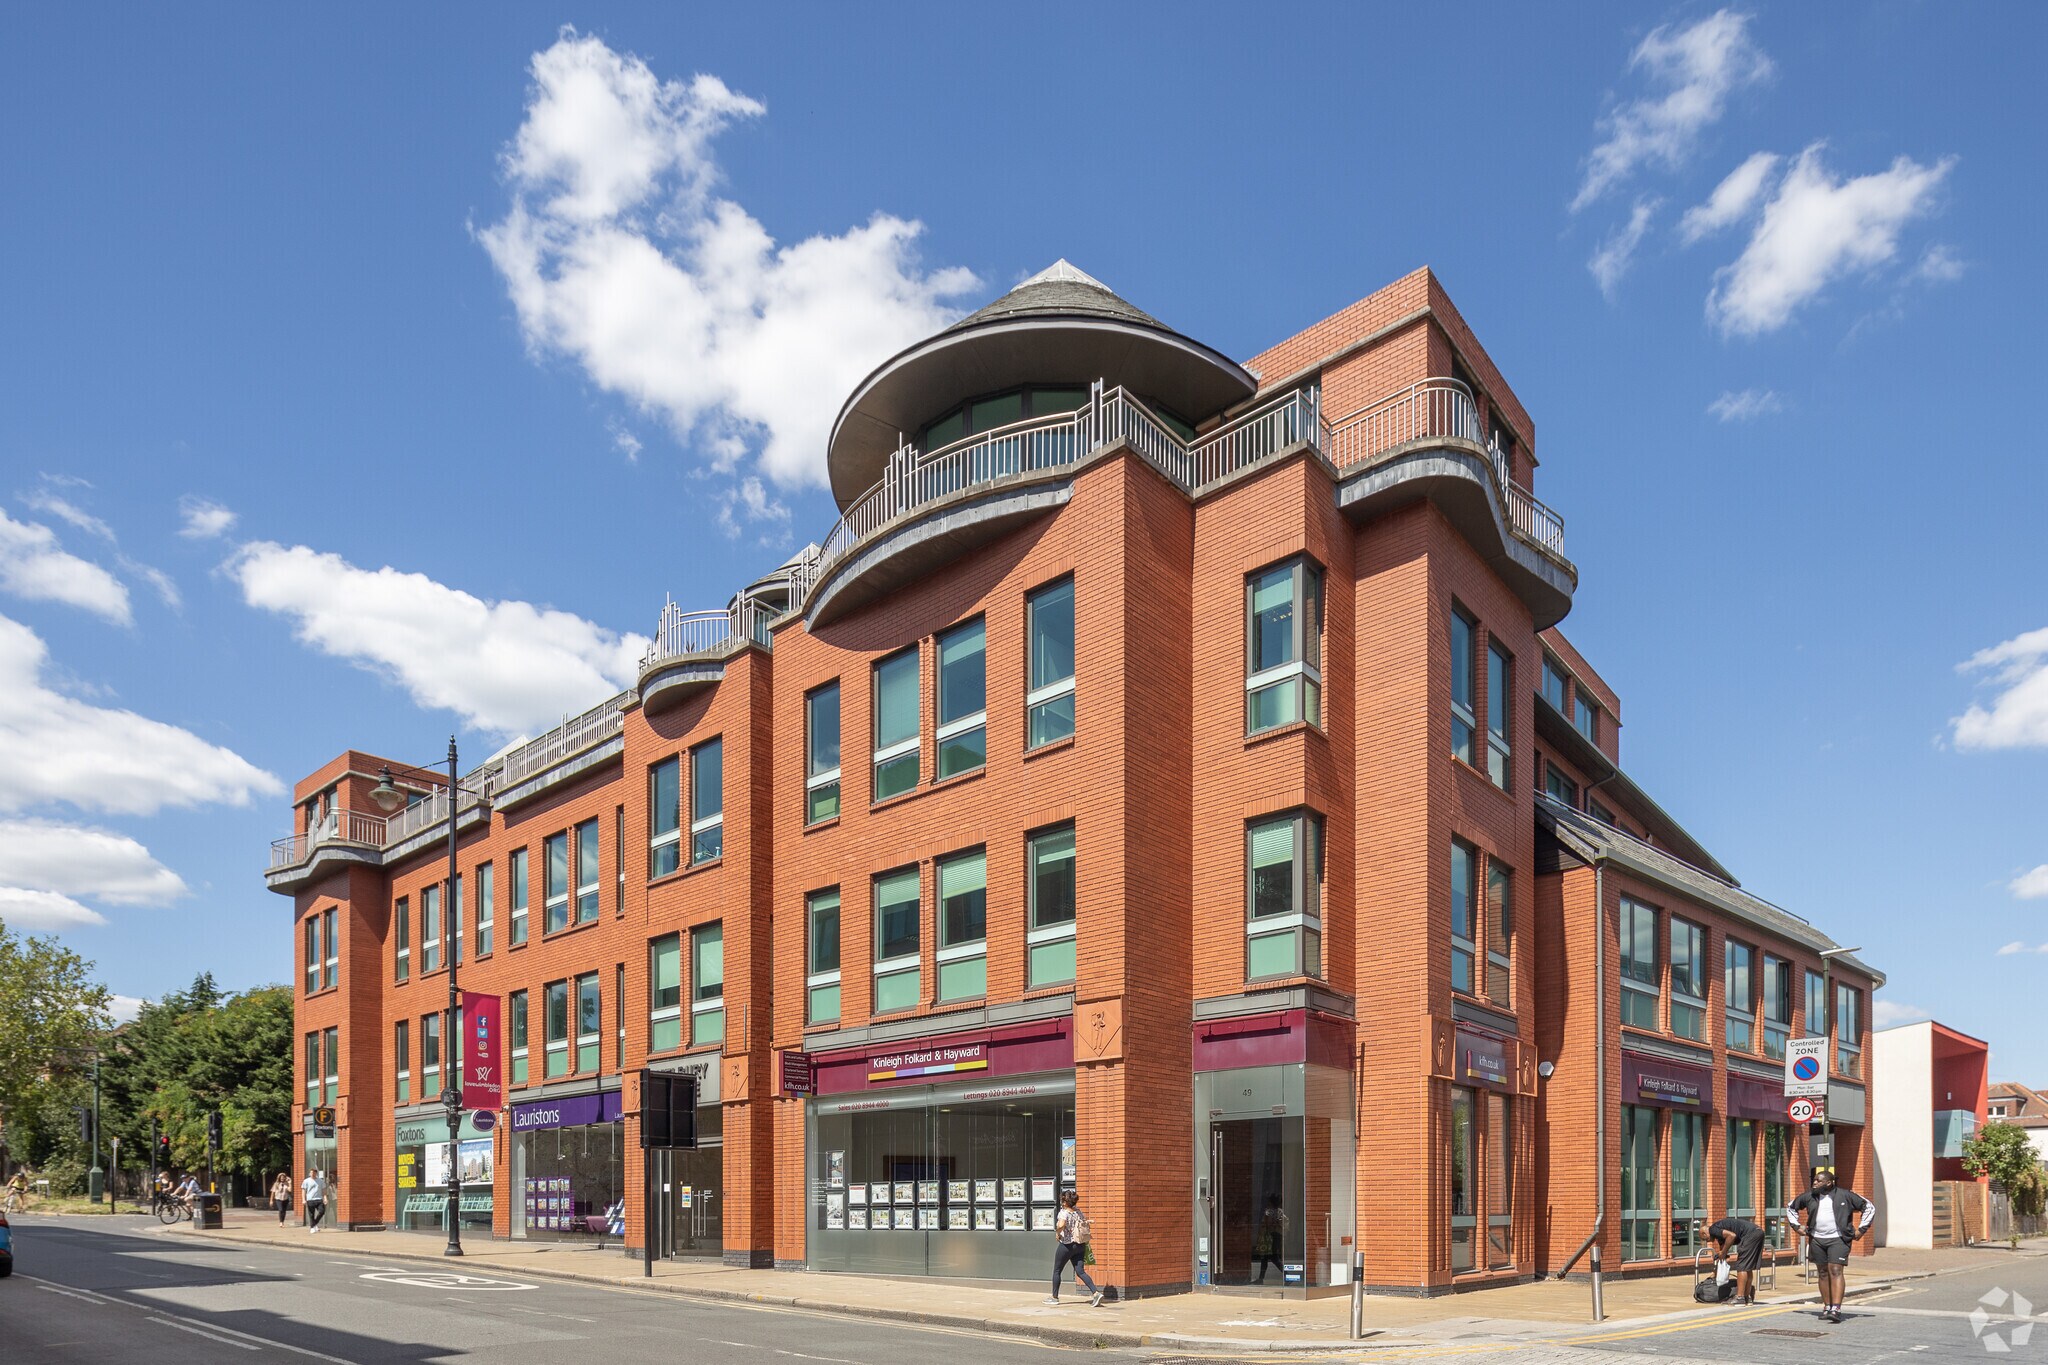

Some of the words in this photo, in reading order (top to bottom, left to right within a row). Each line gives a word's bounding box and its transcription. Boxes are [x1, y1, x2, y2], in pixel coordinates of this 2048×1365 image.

[1790, 1039, 1825, 1047] Controlled
[873, 1055, 902, 1068] Kinleigh
[904, 1051, 932, 1064] Folkard
[934, 1050, 941, 1060] &
[943, 1045, 980, 1060] Hayward
[1795, 1047, 1819, 1055] ZONE
[784, 1082, 810, 1090] kfh.co.uk
[1643, 1078, 1660, 1091] Kinleigh
[1661, 1081, 1676, 1092] Folkard
[1676, 1084, 1680, 1092] &
[1680, 1084, 1698, 1096] Hayward
[963, 1091, 988, 1100] Lettings
[988, 1089, 1001, 1098] 020
[1001, 1087, 1018, 1096] 8944
[1018, 1085, 1036, 1094] 4040
[1242, 1088, 1252, 1097] 49
[838, 1104, 850, 1112] Sales
[851, 1103, 862, 1111] 020
[875, 1100, 890, 1108] 4000
[1792, 1105, 1811, 1116] 20
[319, 1111, 328, 1122] F
[514, 1108, 559, 1127] Lauristons
[397, 1126, 425, 1142] Foxtons
